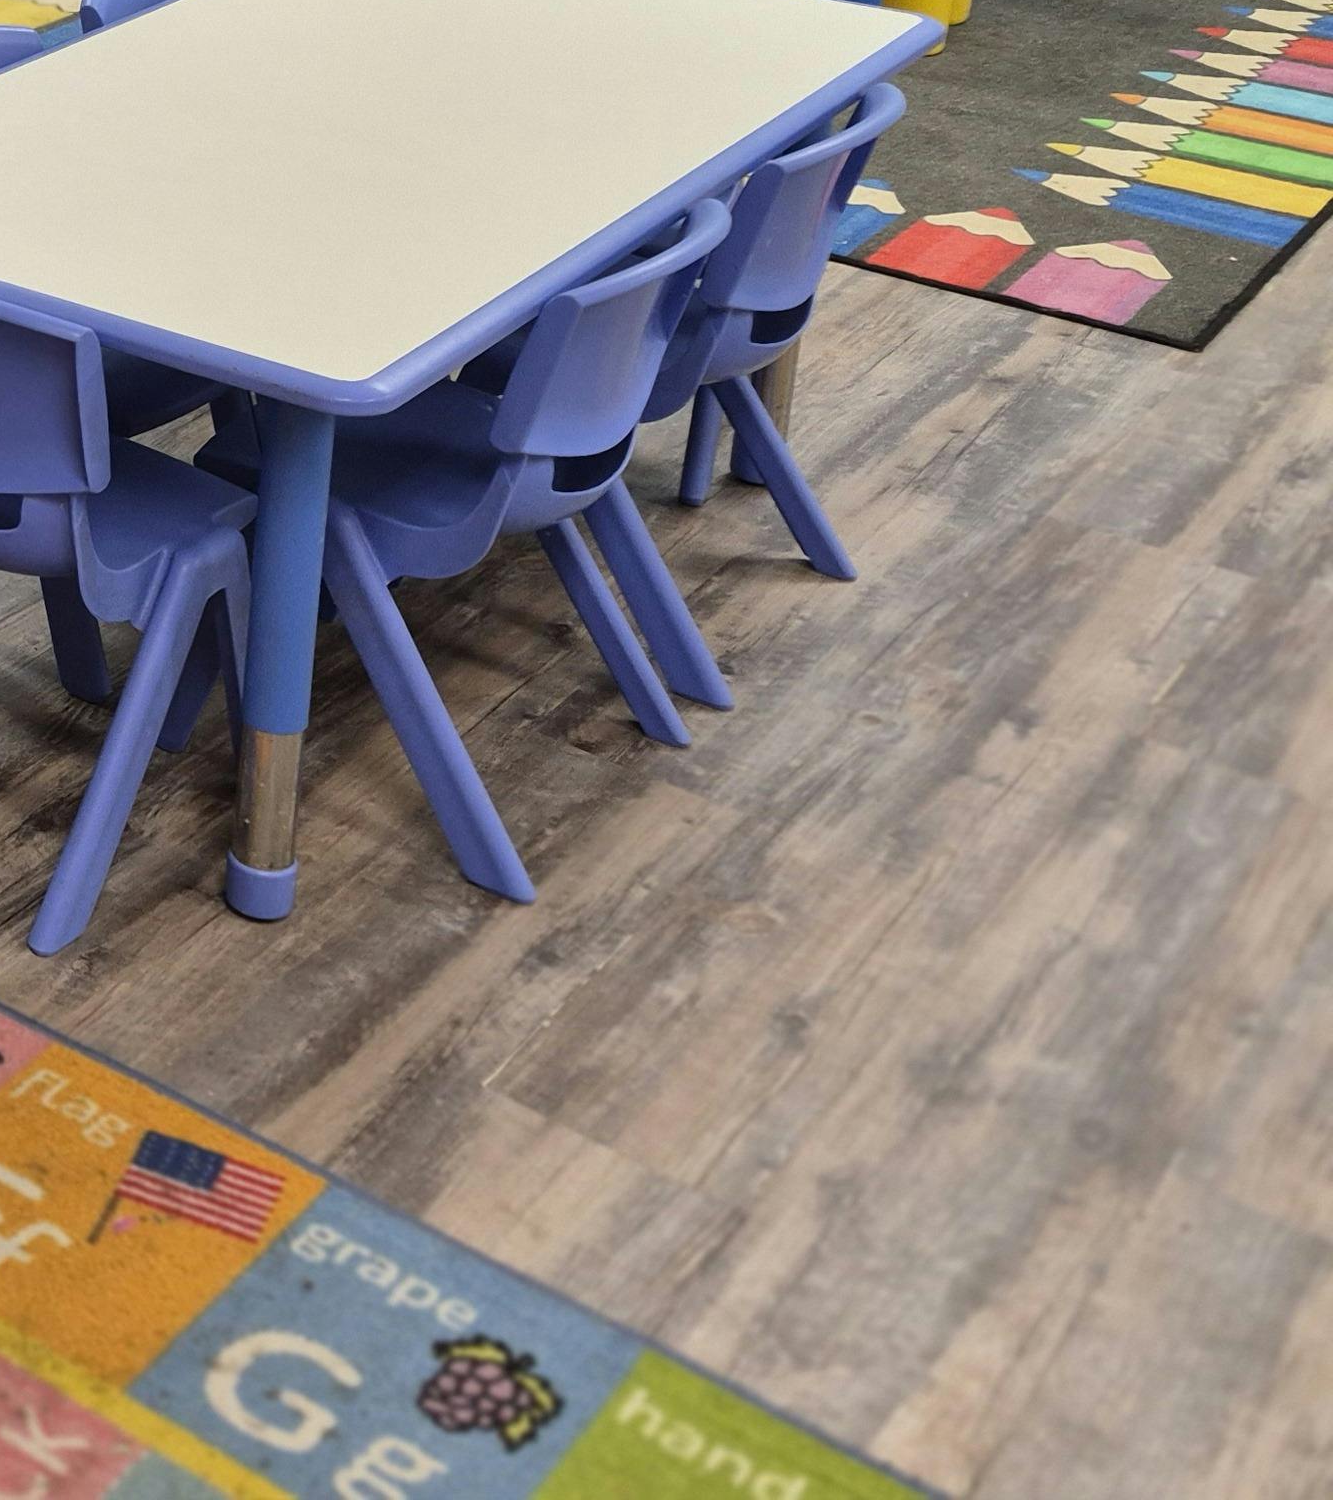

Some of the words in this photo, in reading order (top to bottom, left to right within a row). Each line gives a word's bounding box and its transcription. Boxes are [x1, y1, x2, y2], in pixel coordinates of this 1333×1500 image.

[10, 1066, 133, 1150] flag
[289, 1223, 478, 1333] grape
[616, 1387, 808, 1500] hand
